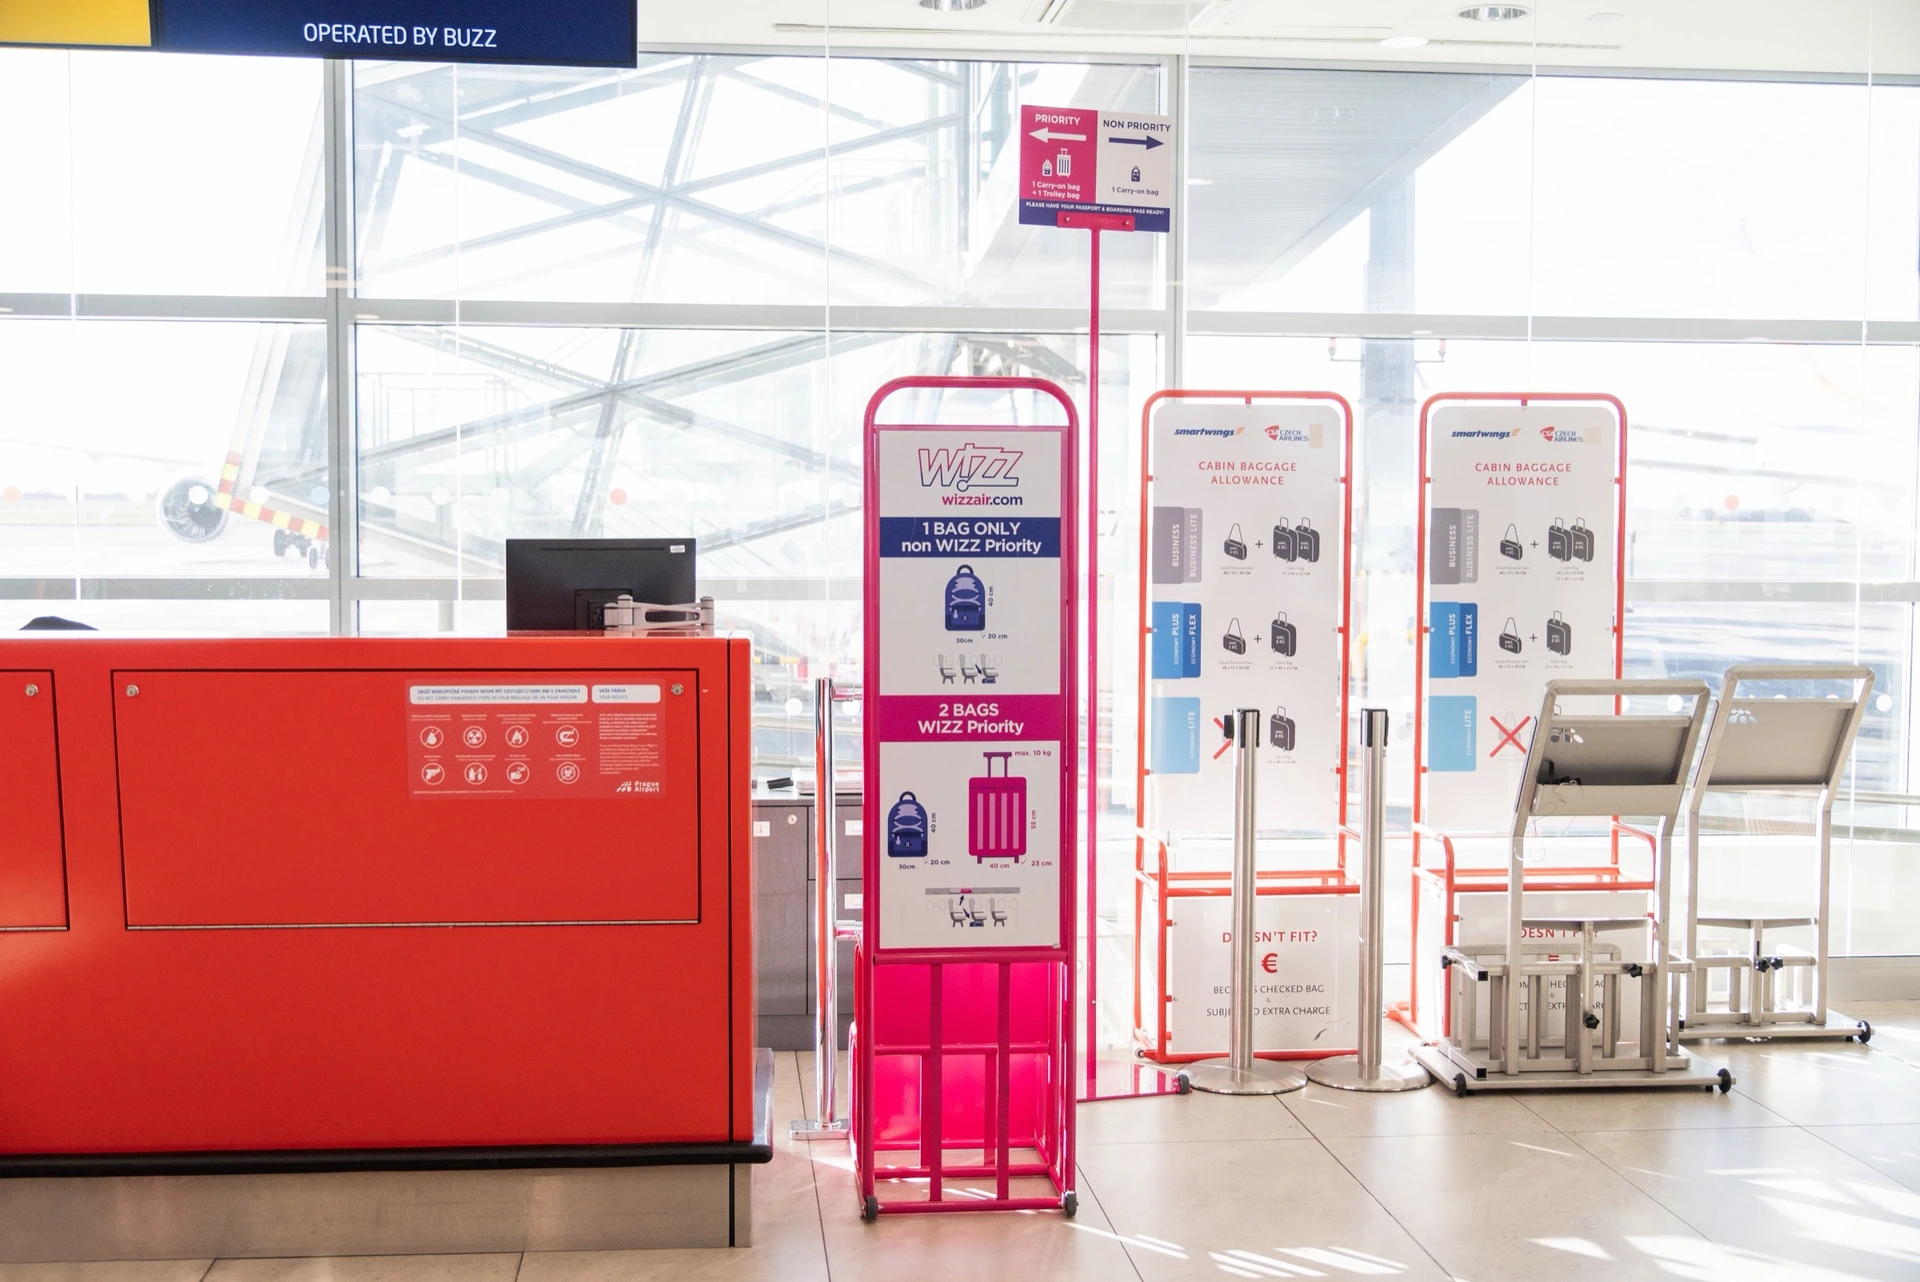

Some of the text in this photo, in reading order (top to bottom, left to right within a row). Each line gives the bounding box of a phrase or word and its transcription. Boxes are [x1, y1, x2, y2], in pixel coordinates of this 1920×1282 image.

[304, 23, 497, 48] OPERATED BY BUZZ
[1035, 114, 1080, 126] PRIORITY
[1103, 120, 1171, 133] NON PRIORITY
[1037, 181, 1065, 190] Carry-on
[1067, 183, 1080, 191] bag
[1116, 187, 1144, 195] Carry-on
[1147, 188, 1159, 196] bag
[1043, 190, 1065, 199] Trolley
[1067, 191, 1080, 200] bag
[1174, 428, 1235, 438] smartwings
[1451, 430, 1511, 440] smartwings
[1198, 462, 1297, 472] CABIN BAGGAGE
[1475, 463, 1571, 473] CABIN BAGGAGE
[1211, 476, 1284, 485] ALLOWANCE
[1487, 477, 1559, 486] ALLOWANCE
[941, 494, 1023, 506] wizzair.com
[923, 522, 1021, 535] 1 BAG ONLY
[901, 539, 1042, 555] non WIZZ Priority
[1172, 523, 1180, 567] BUSINESS
[1190, 513, 1198, 577] BUSINESS LITE
[1449, 525, 1457, 568] BUSINESS
[1466, 514, 1474, 578] BUSINESS LITE
[1189, 614, 1197, 635] FLEX
[1465, 614, 1473, 635] FLEX
[939, 703, 999, 717] 2 BAGS
[1188, 710, 1196, 729] LITE
[1464, 709, 1472, 727] LITE
[918, 720, 1024, 735] WIZZ Priority
[1043, 750, 1052, 758] kg
[1032, 810, 1036, 820] cm
[930, 812, 936, 833] 40 cm
[1222, 930, 1318, 943] DSN'T FIT?
[1261, 952, 1278, 974] €
[1260, 985, 1303, 994] CHECKED
[1305, 984, 1325, 993] BAG
[1262, 1007, 1291, 1016] EXTRA
[1292, 1006, 1330, 1015] CHARGE
